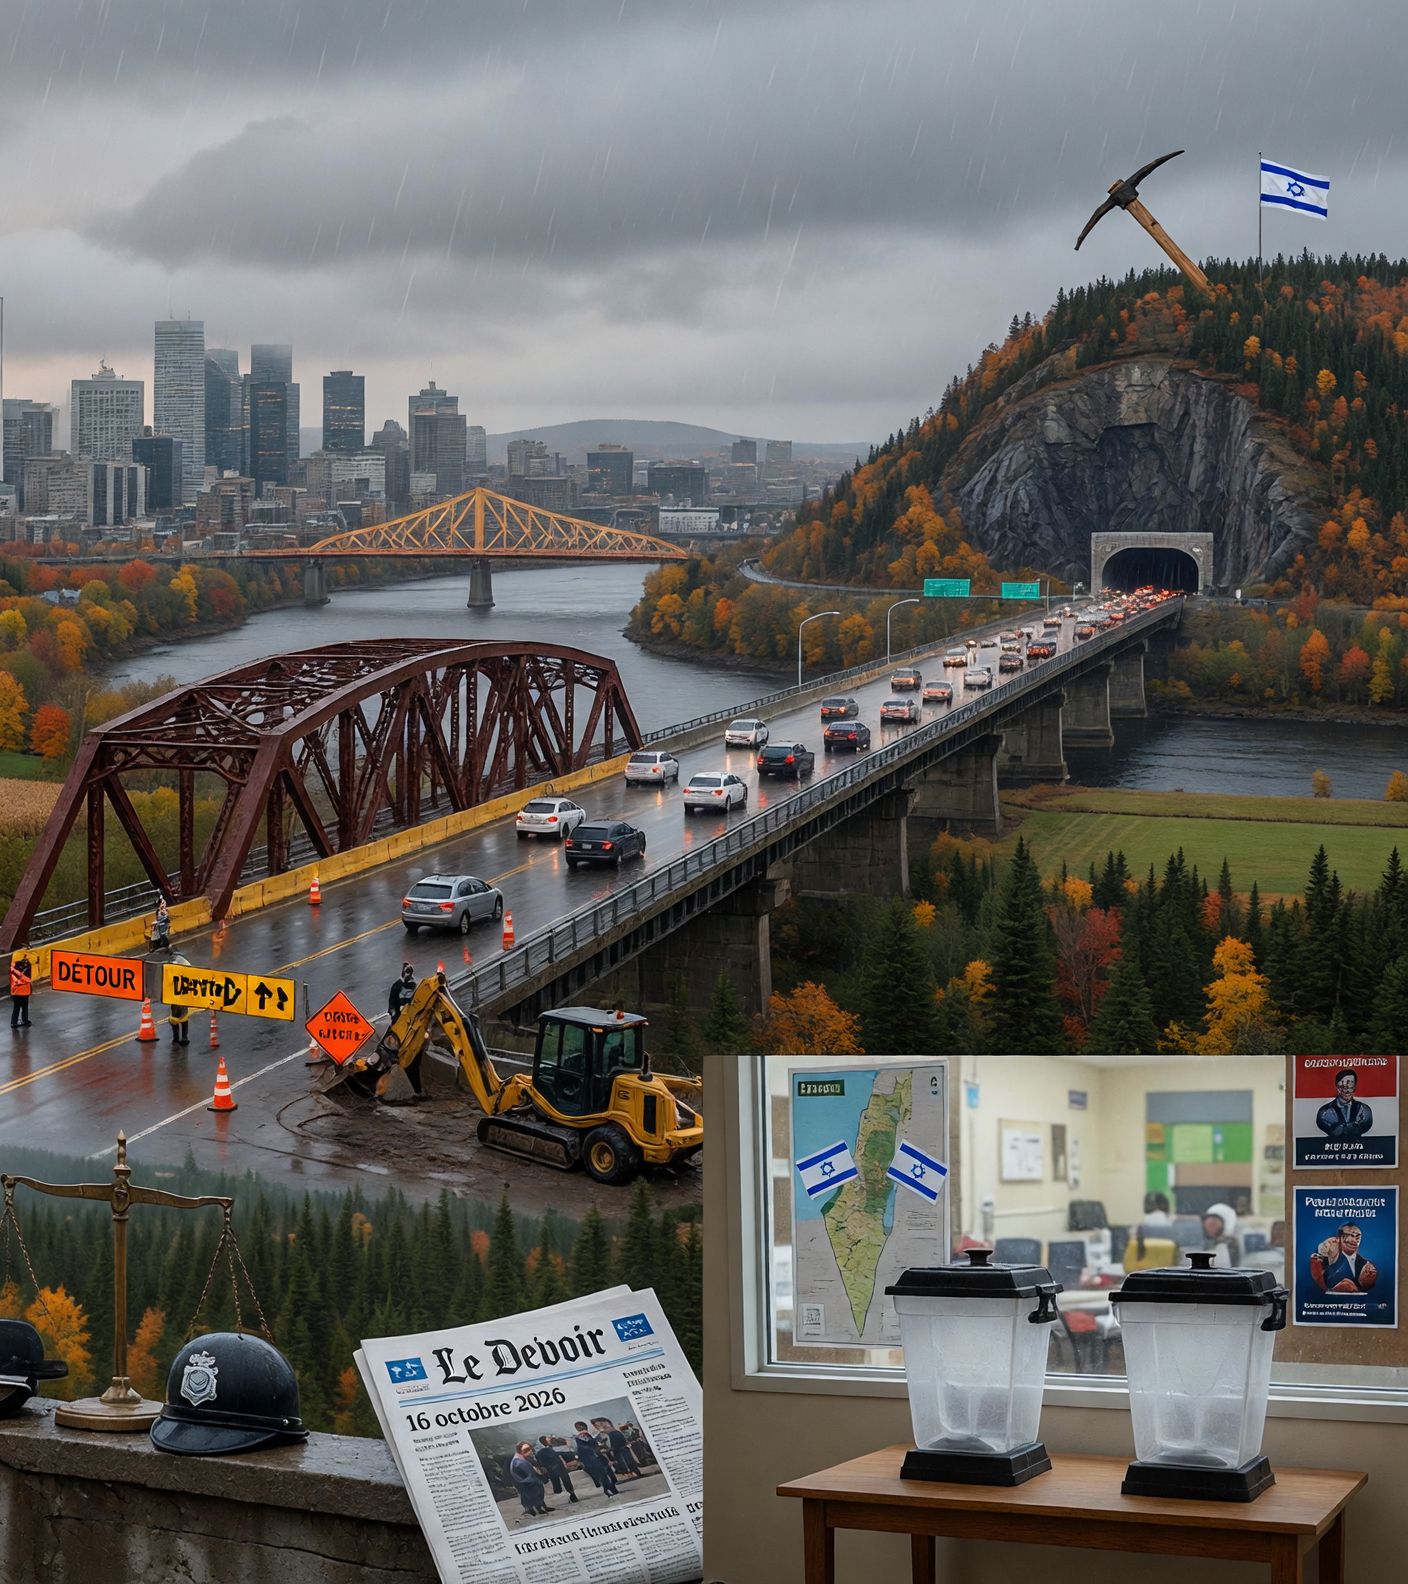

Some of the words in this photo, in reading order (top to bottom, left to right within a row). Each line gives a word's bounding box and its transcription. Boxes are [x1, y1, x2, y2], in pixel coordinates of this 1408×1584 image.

[58, 957, 136, 992] DÉTOUR
[431, 1345, 484, 1386] Le
[484, 1324, 608, 1377] Devoir
[405, 1411, 431, 1433] 16
[435, 1399, 512, 1427] octobre
[517, 1387, 567, 1413] 2026
